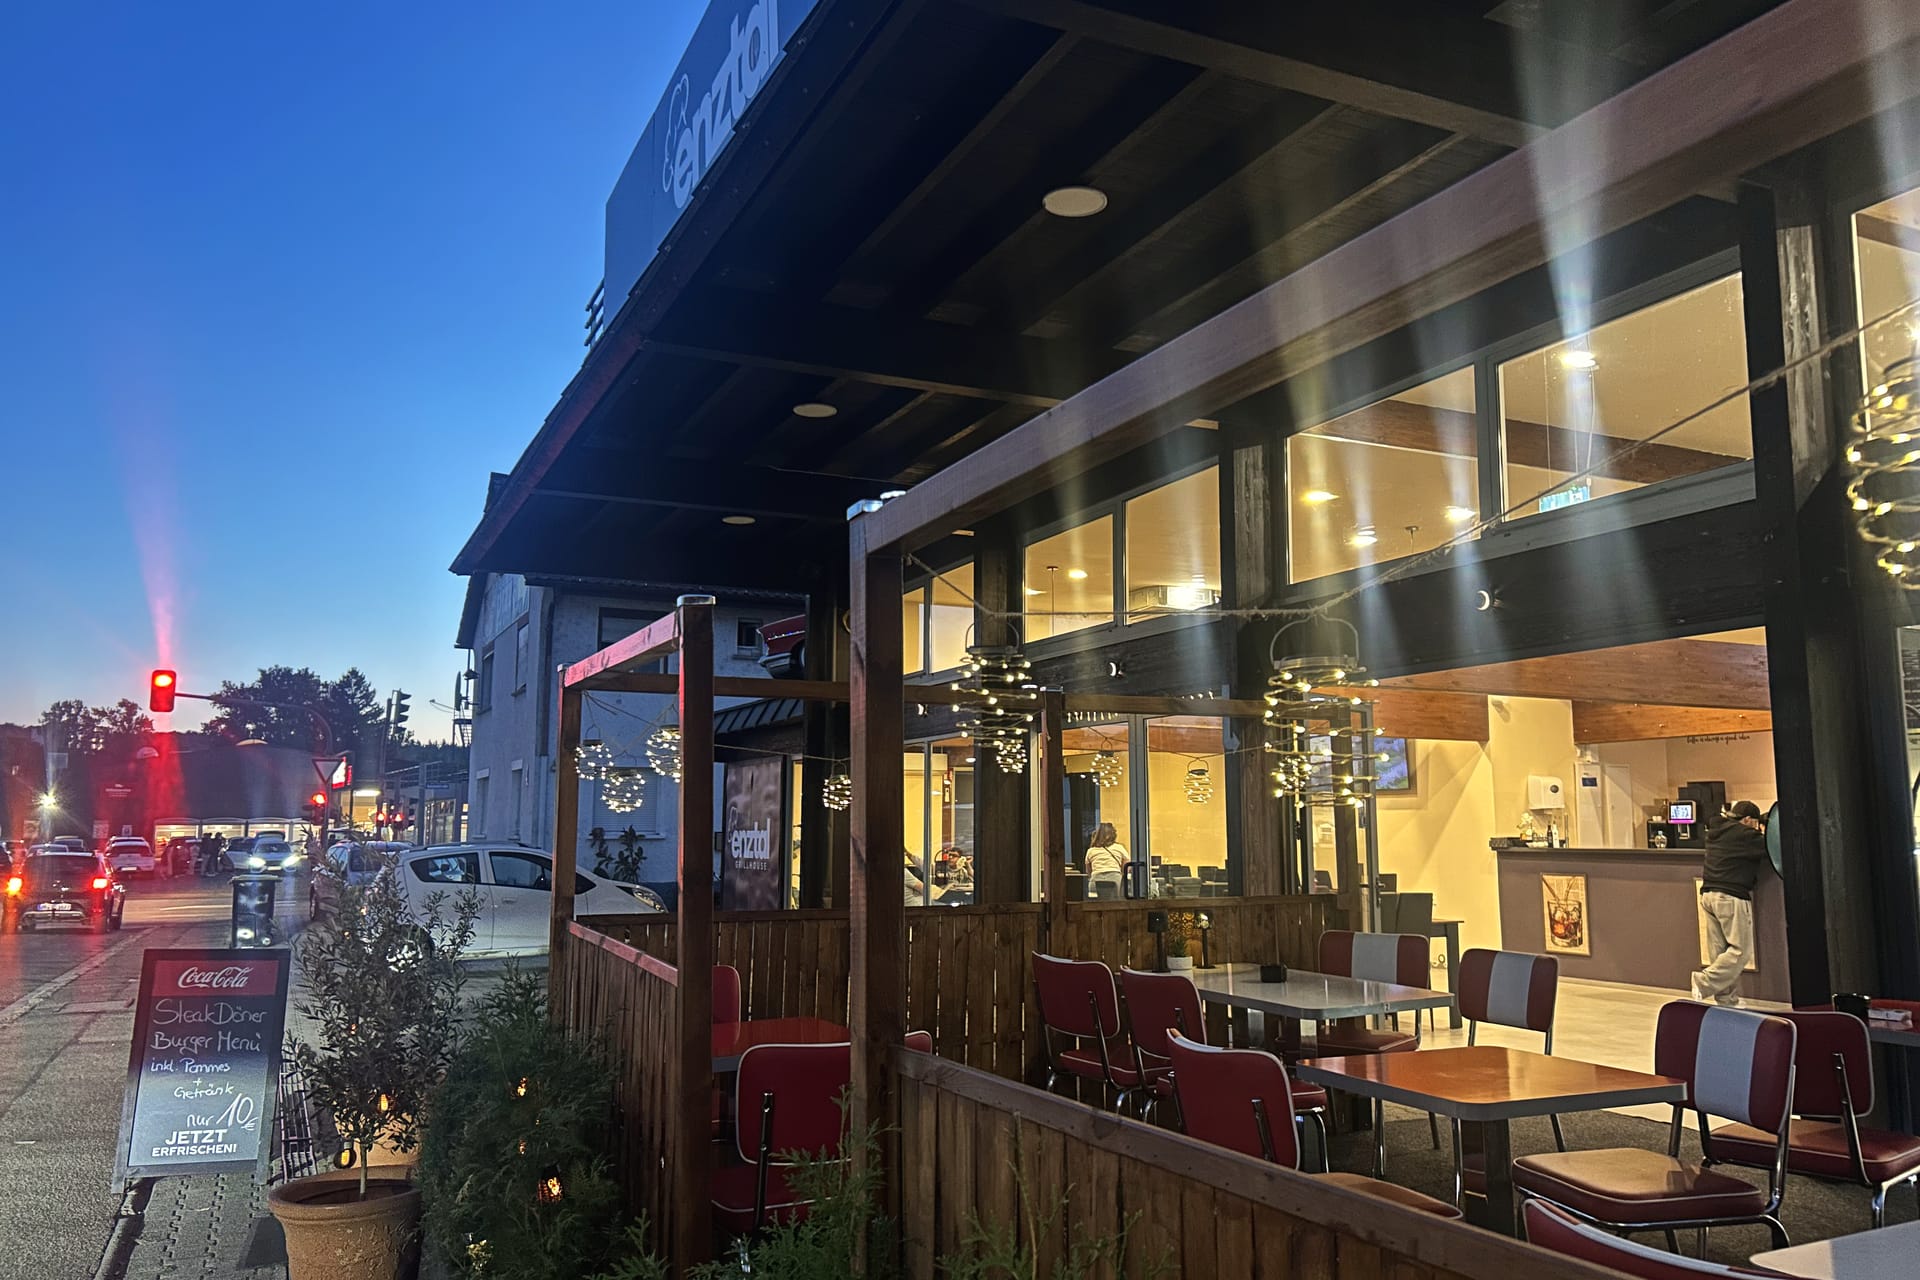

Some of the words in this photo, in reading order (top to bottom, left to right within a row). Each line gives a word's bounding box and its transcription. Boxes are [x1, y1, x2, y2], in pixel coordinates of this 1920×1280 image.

[673, 0, 779, 208] enztal
[732, 817, 771, 859] enztal
[178, 966, 253, 989] Coca-Cola
[214, 1002, 268, 1025] Döner
[150, 1031, 212, 1054] Burger
[217, 1031, 262, 1052] Menü
[181, 1057, 231, 1073] Pommes
[174, 1082, 235, 1099] Getränk
[187, 1114, 213, 1127] nur
[165, 1129, 228, 1146] JETZT
[151, 1143, 237, 1157] ERFRISCHEN!
